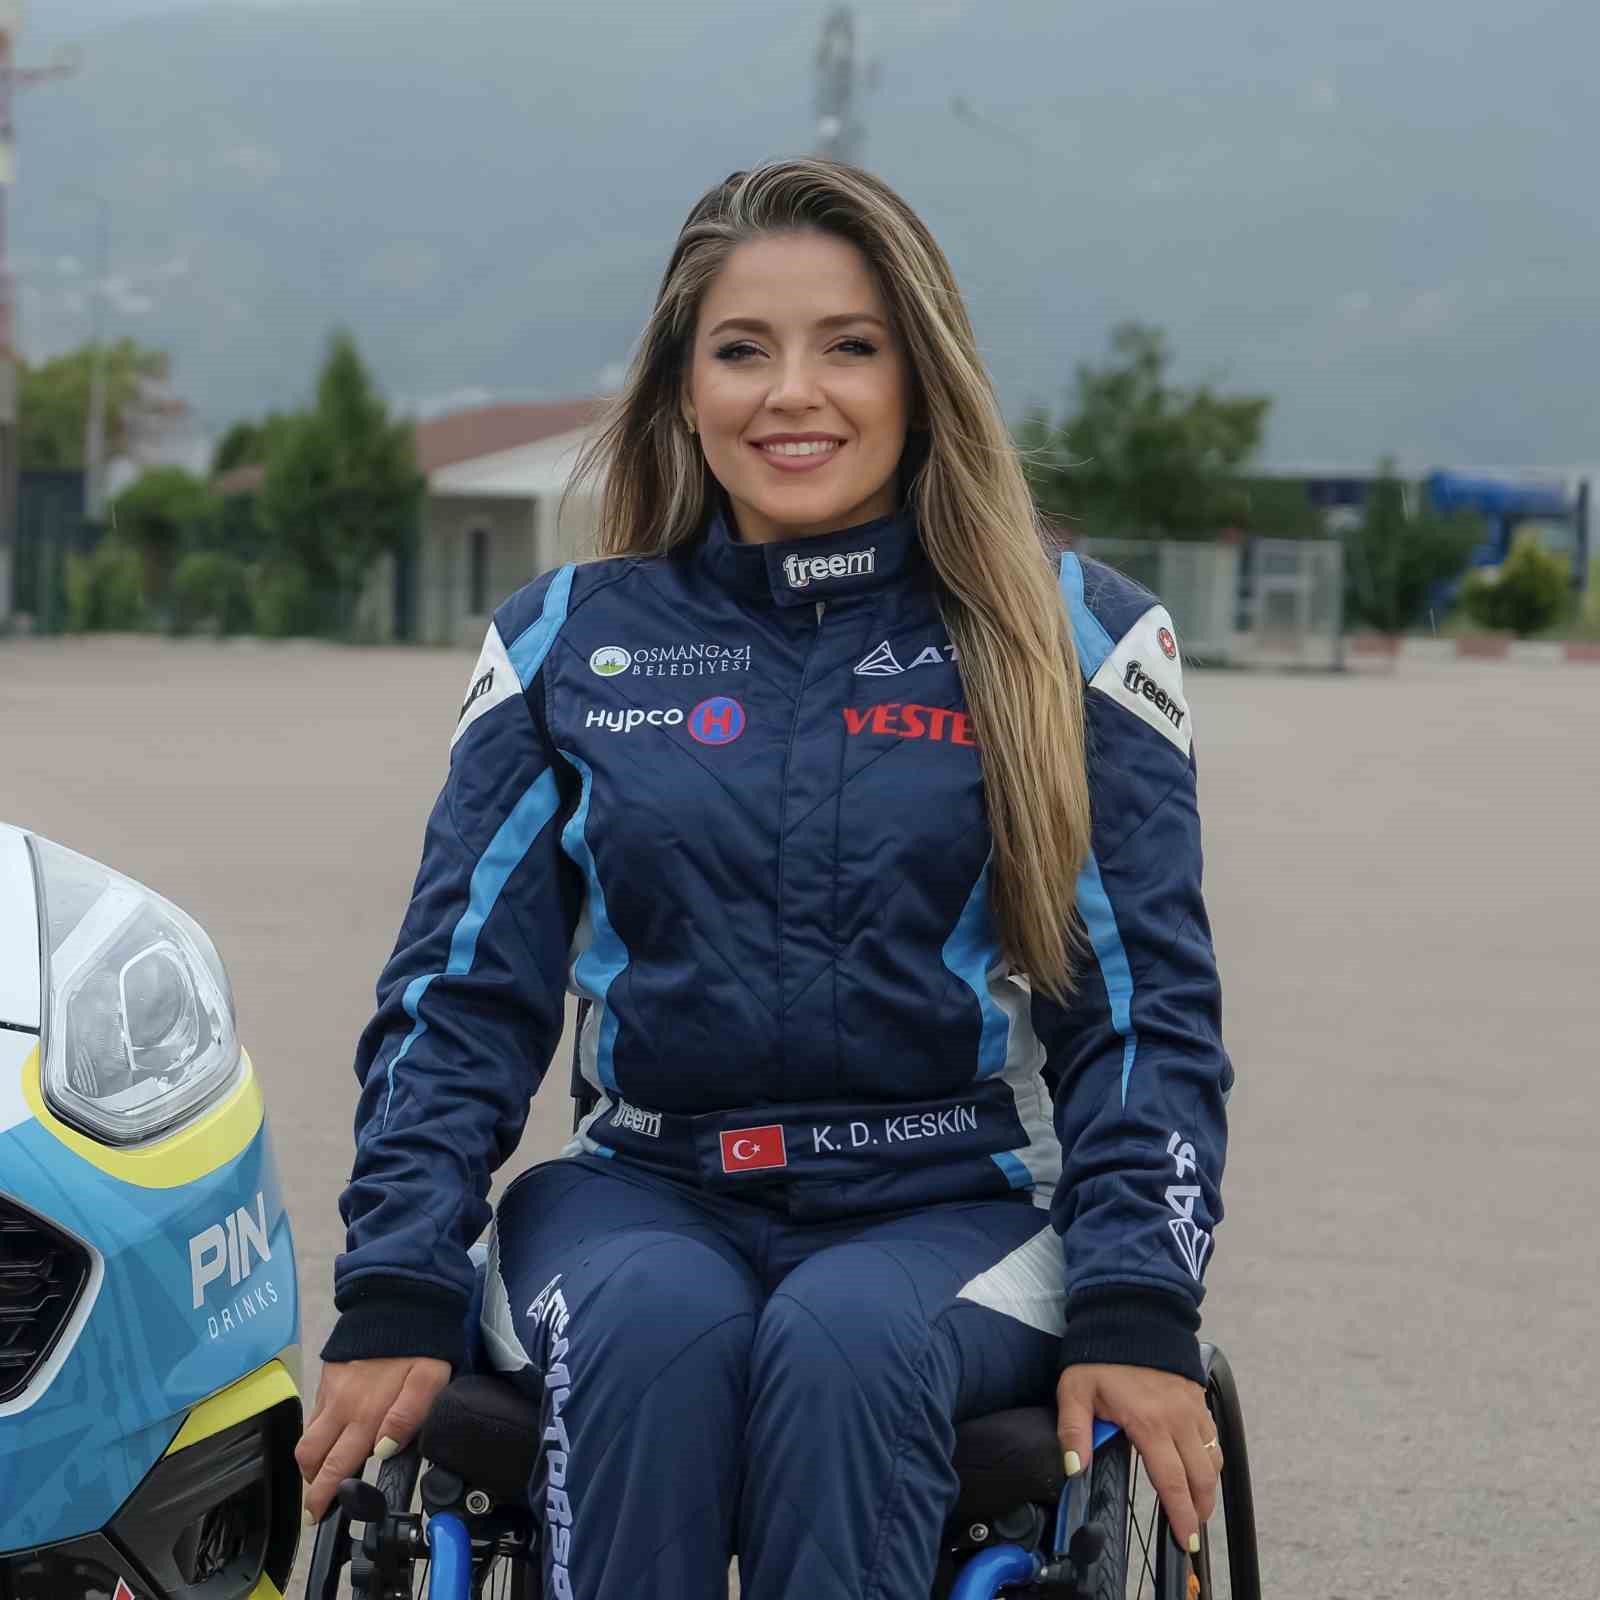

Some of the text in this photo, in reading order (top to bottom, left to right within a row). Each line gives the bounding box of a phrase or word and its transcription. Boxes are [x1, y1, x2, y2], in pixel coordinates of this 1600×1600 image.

[782, 547, 876, 588] freem
[907, 644, 960, 669] AT
[1123, 659, 1185, 729] freem
[843, 703, 977, 745] VESTE
[812, 1125, 842, 1152] K.
[850, 1121, 879, 1147] D.
[188, 1191, 273, 1309] PIN
[207, 1280, 279, 1339] DRINKS
